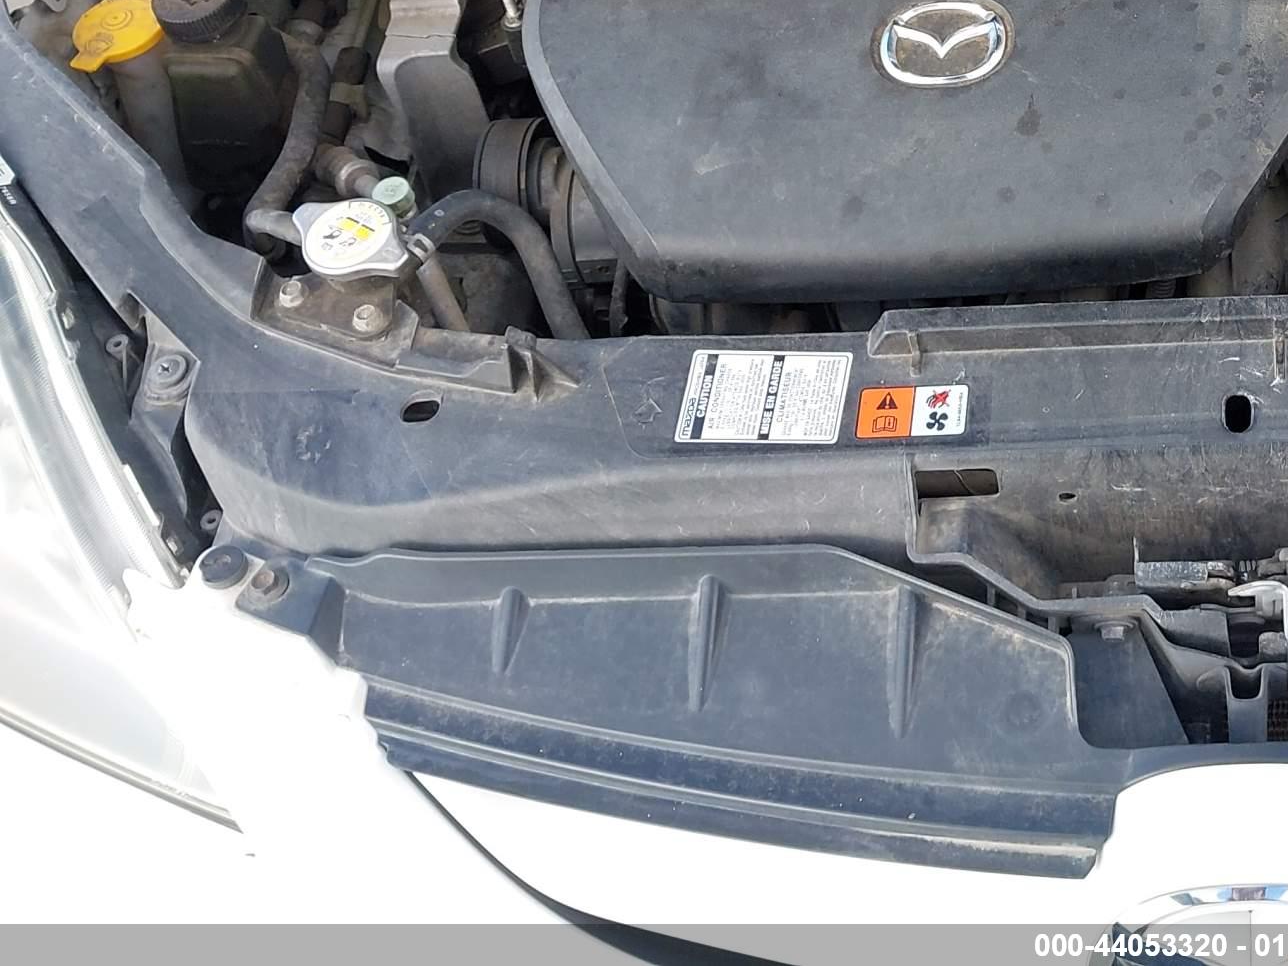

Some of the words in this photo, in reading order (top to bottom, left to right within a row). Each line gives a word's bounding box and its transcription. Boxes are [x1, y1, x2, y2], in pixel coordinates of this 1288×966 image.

[696, 374, 714, 418] CAUTION
[711, 363, 727, 414] CONDITIONER
[768, 360, 783, 394] GARDE
[681, 397, 697, 436] mazda
[765, 395, 776, 410] EN
[776, 371, 792, 423] CLIMATISEUR
[760, 410, 773, 435] MISE
